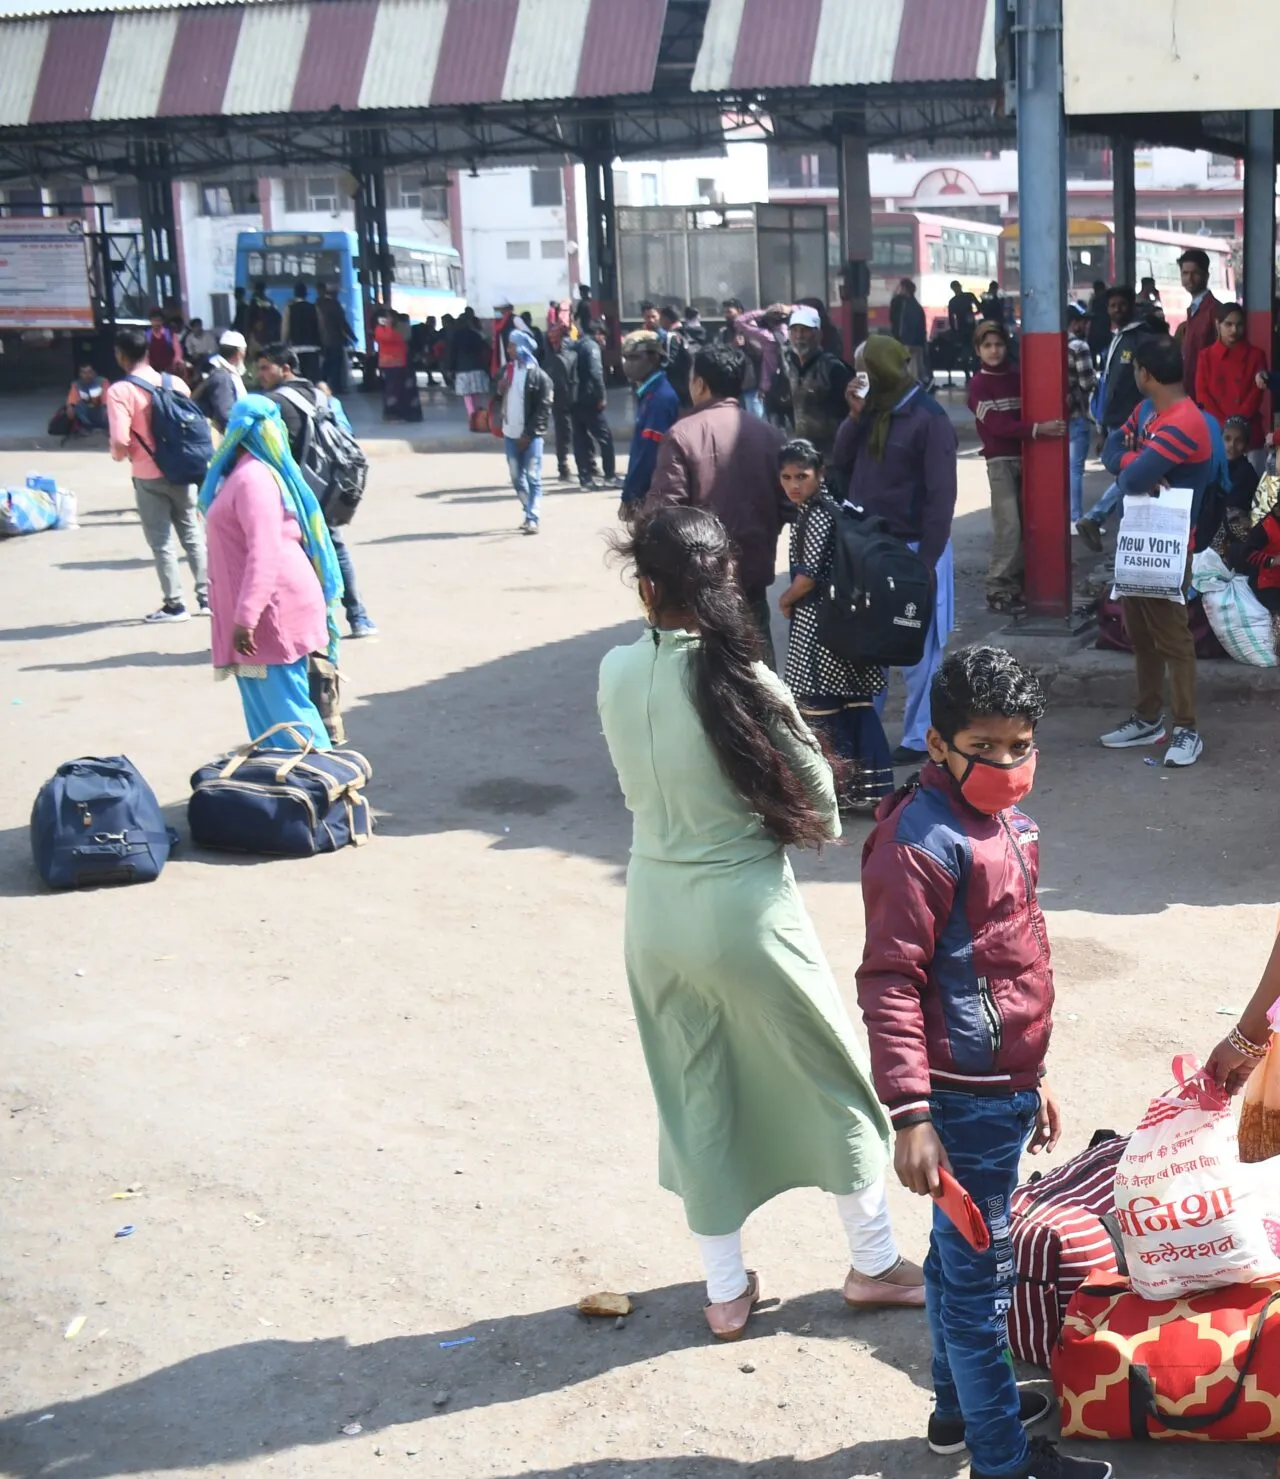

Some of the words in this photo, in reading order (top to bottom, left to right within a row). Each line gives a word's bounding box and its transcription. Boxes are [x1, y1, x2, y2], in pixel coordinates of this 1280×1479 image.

[1119, 536, 1145, 552] New
[1149, 537, 1181, 555] York
[1123, 555, 1171, 569] FASHION
